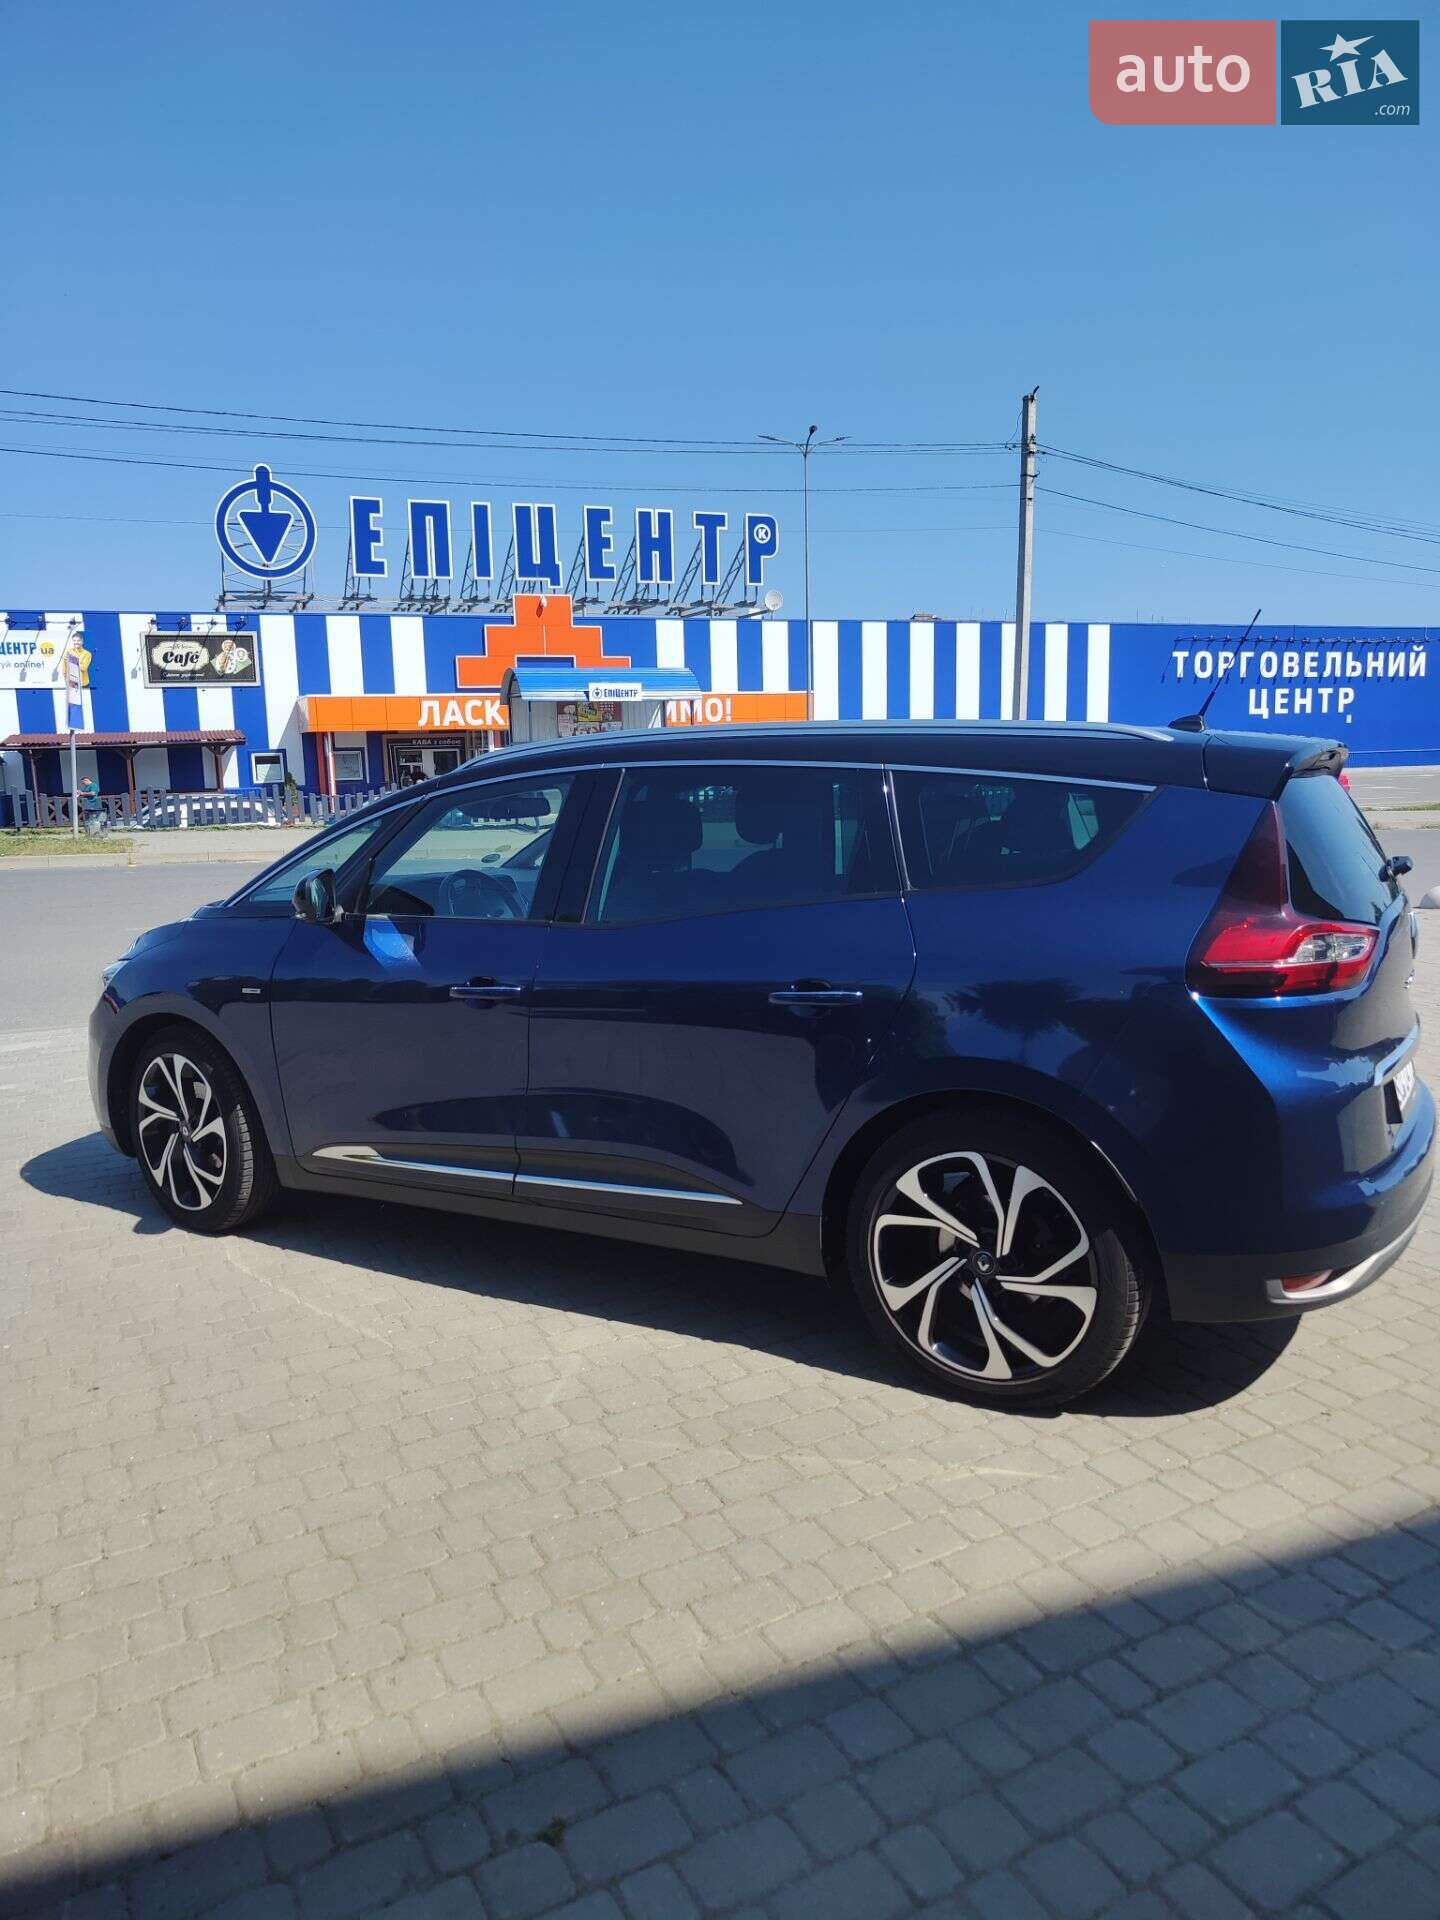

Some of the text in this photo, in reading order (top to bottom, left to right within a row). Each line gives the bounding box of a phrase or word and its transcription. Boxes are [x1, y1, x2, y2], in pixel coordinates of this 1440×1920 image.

[349, 495, 779, 588] ЕПІЦЕНТР
[1172, 645, 1427, 679] ТОРГОВЕЛЬНИЙ
[417, 699, 509, 727] ЛАСК
[1248, 687, 1355, 719] ЦЕНТР
